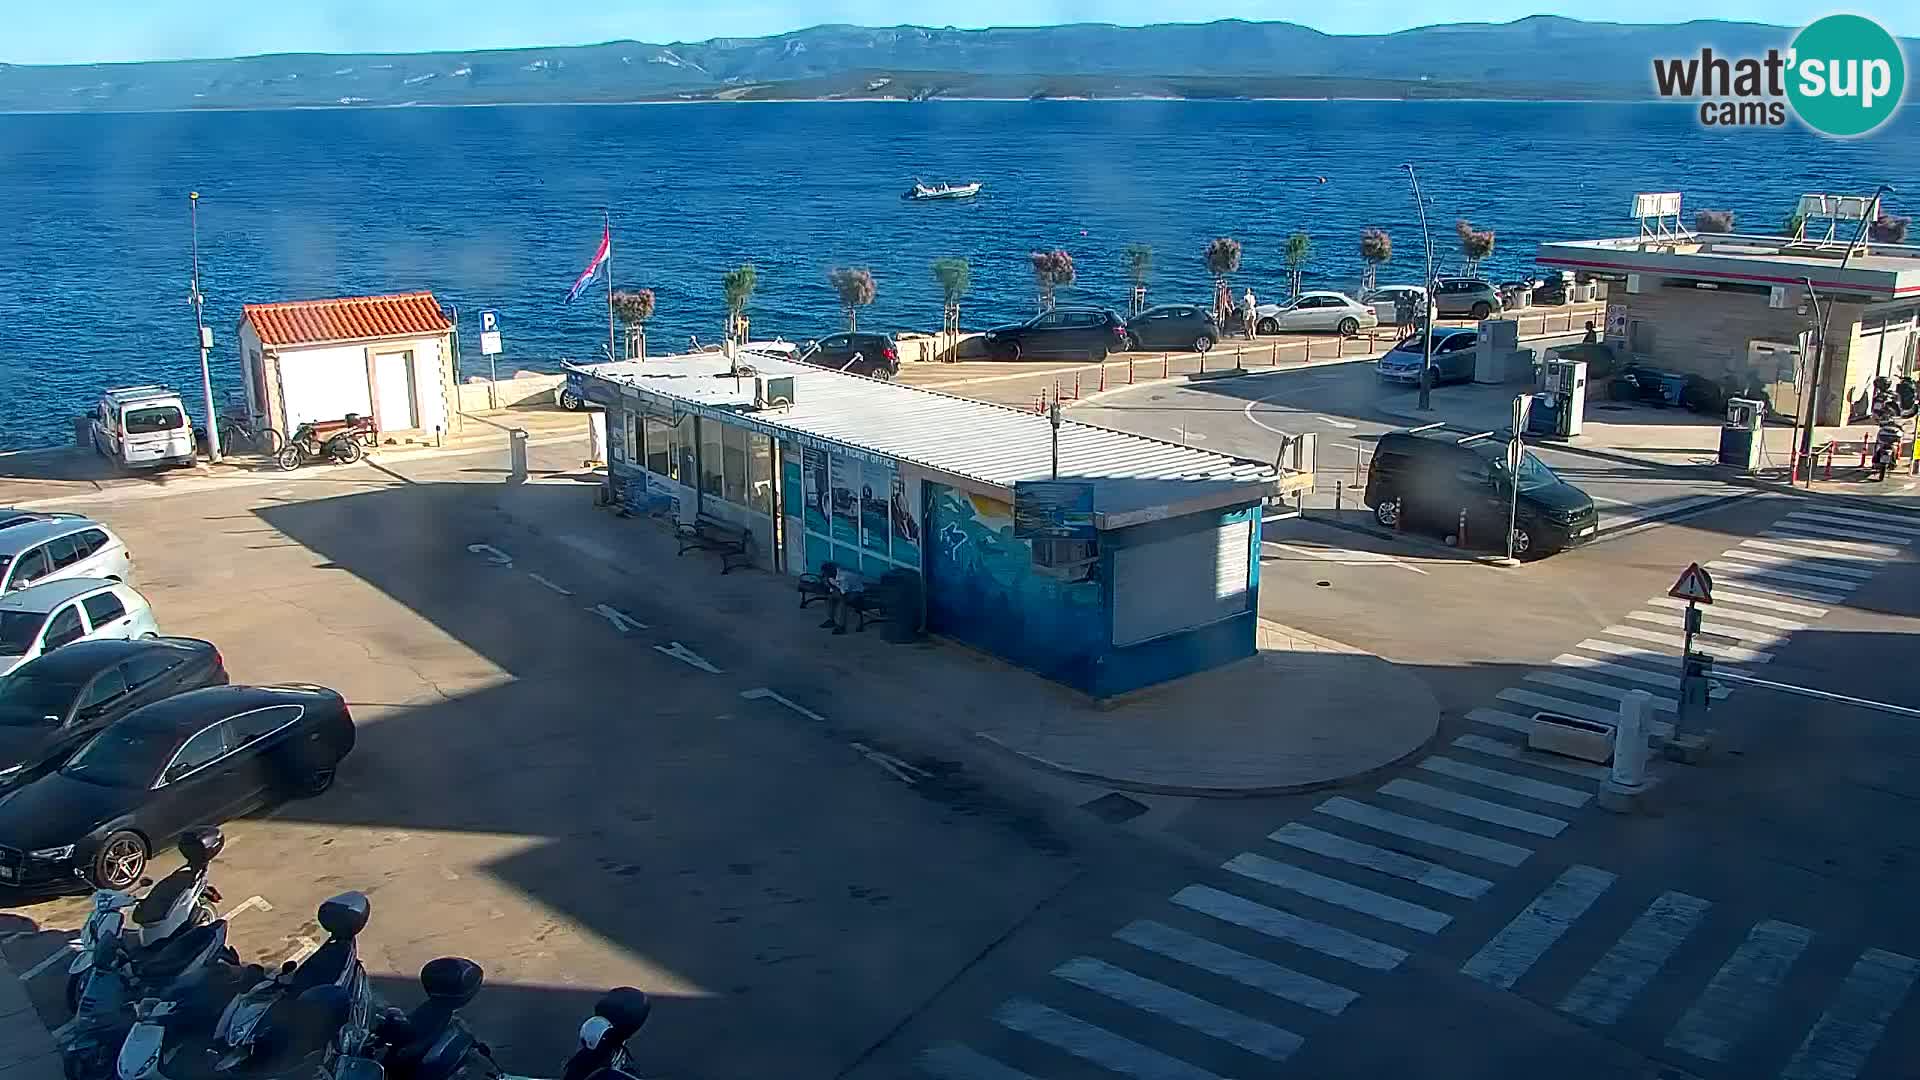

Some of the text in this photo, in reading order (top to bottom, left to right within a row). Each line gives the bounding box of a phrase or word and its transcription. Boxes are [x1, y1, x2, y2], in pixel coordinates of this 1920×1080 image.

[483, 313, 496, 331] P
[811, 437, 842, 454] STATION
[845, 446, 869, 461] TICKET
[870, 453, 896, 468] OFFICE
